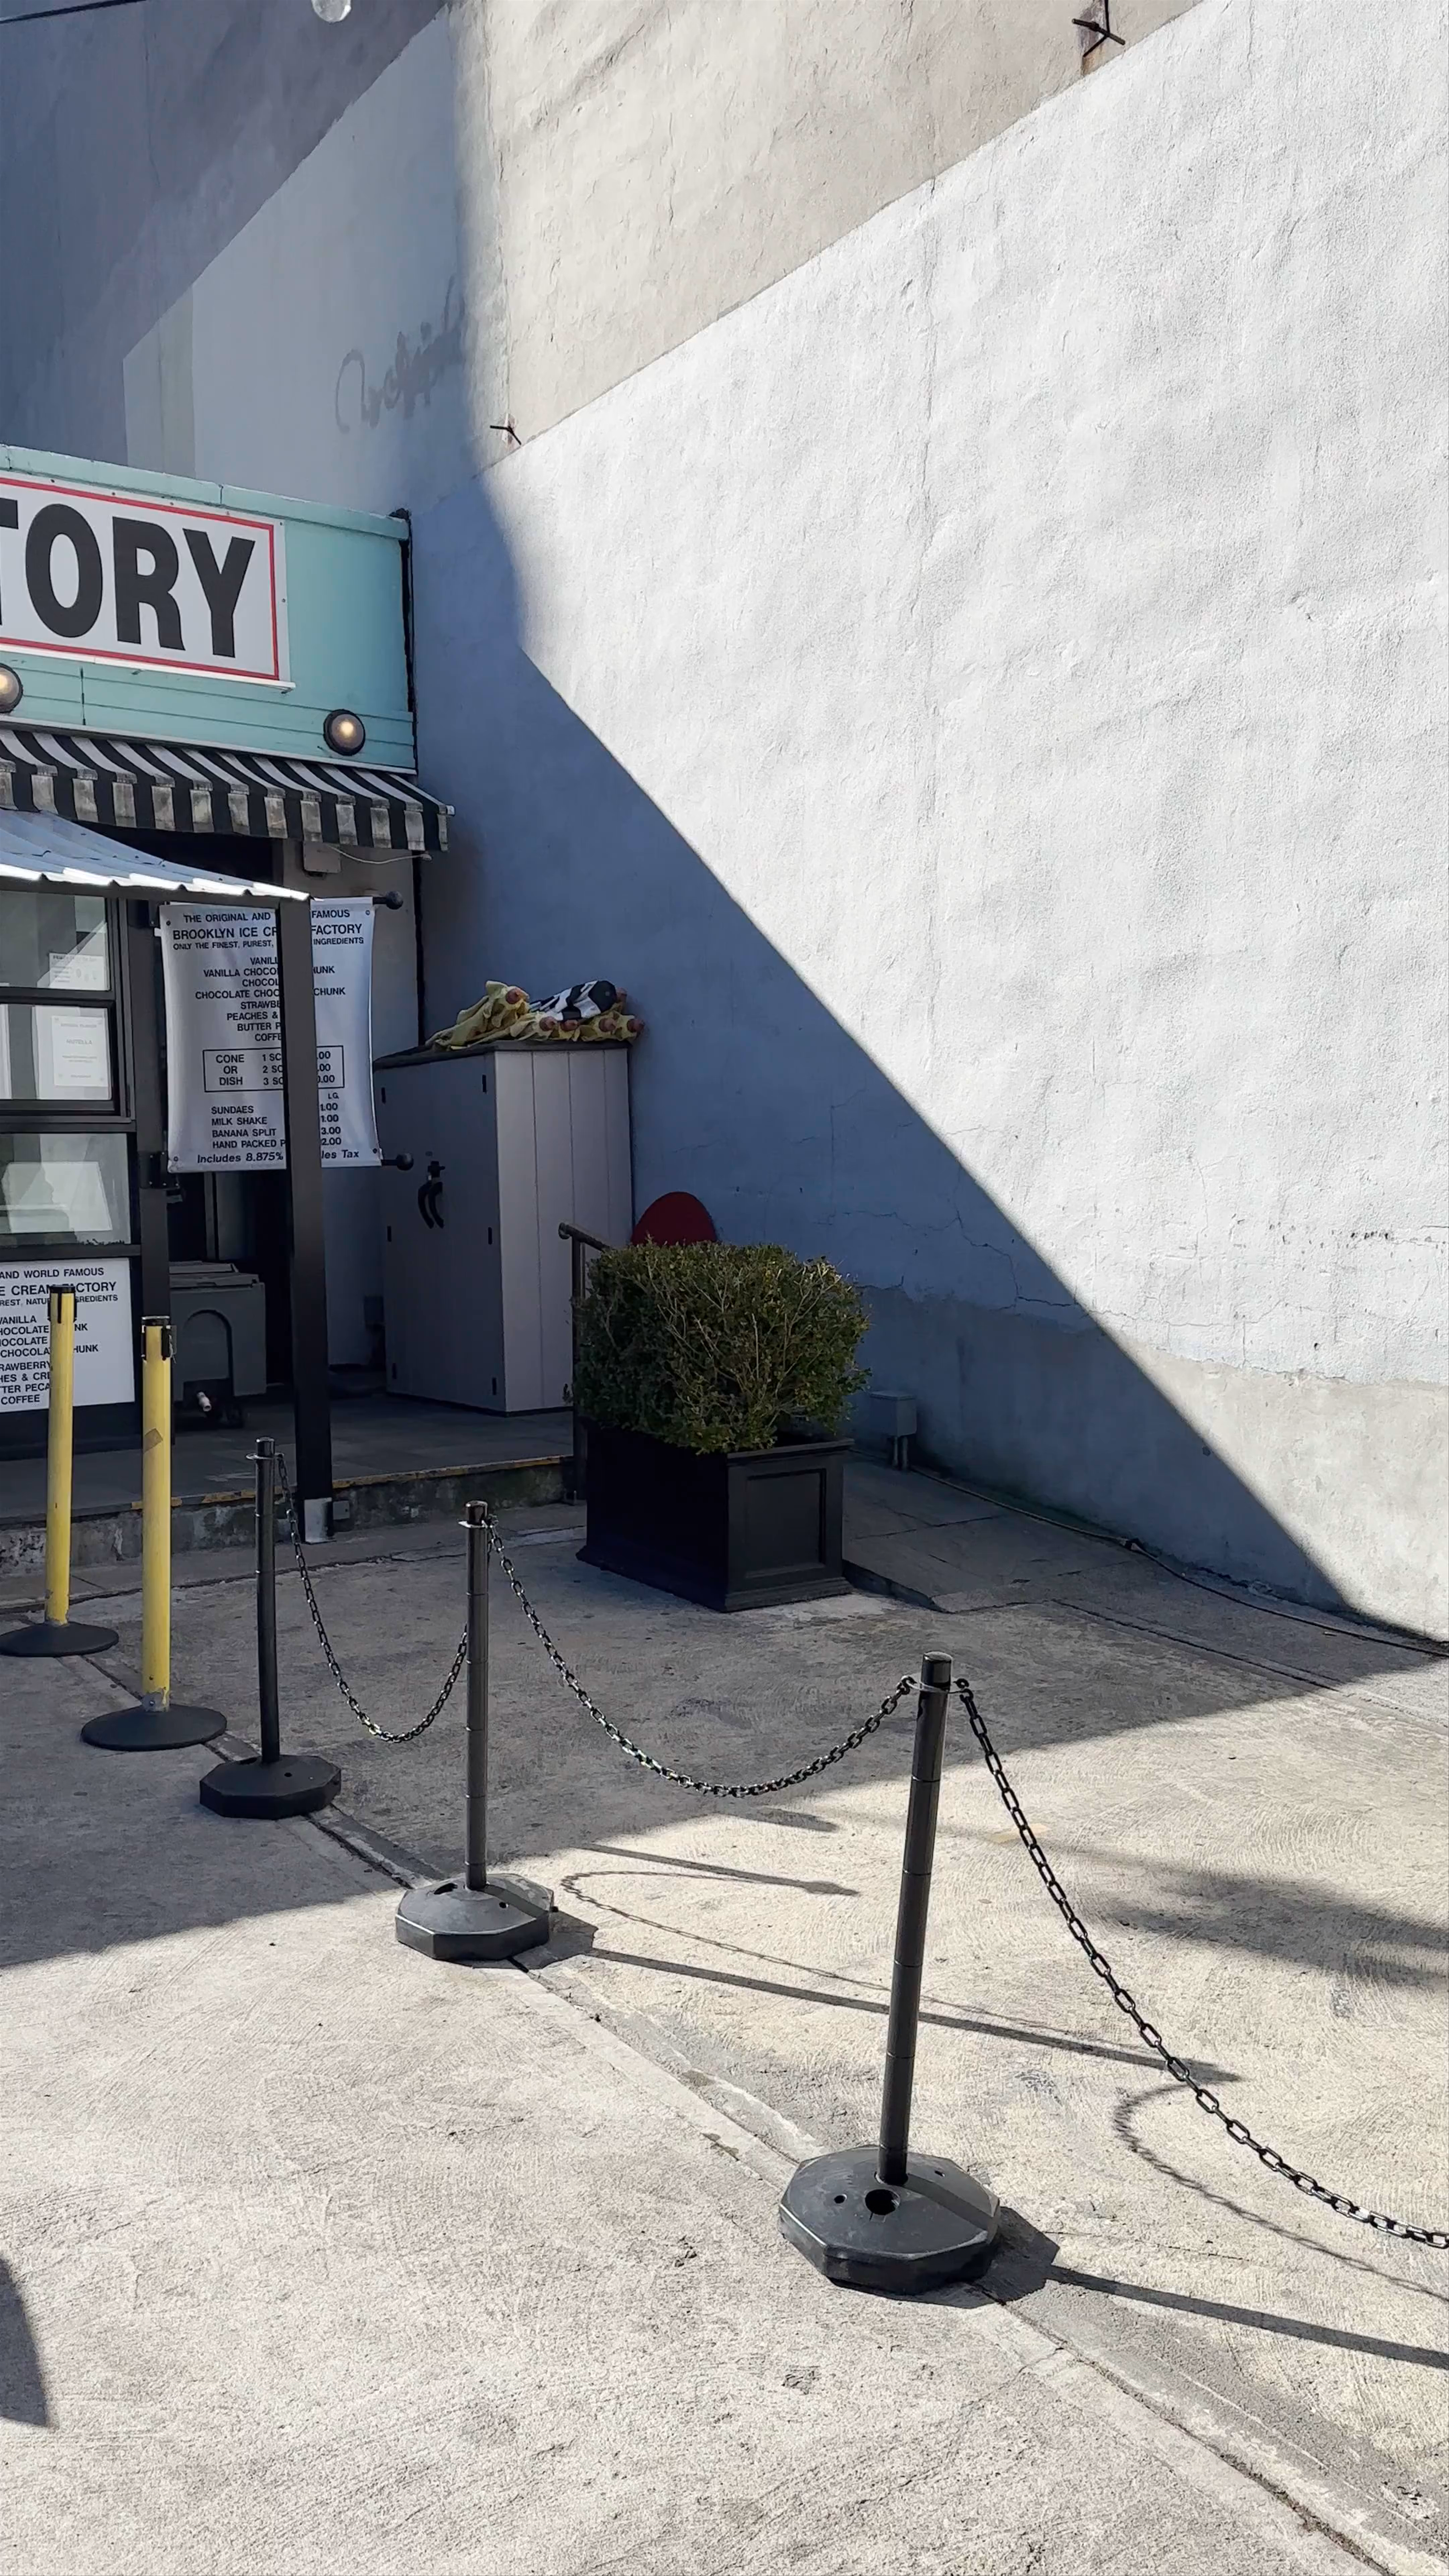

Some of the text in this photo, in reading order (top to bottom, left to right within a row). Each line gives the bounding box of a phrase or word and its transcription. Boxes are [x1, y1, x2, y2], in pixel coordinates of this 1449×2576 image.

[206, 913, 248, 922] ORIGINAL
[252, 912, 271, 920] AND
[312, 910, 350, 918] FAMOUS
[173, 928, 234, 940] BROOKLYN
[240, 927, 258, 937] ICE
[243, 967, 278, 976] CHOCO
[242, 978, 279, 987] CHOCOL
[195, 990, 250, 999] CHOCOLATE
[314, 987, 346, 996] CHUNK
[240, 1000, 280, 1009] STRAWBE
[227, 1012, 268, 1021] PEACHES
[237, 1022, 272, 1031] BUTTER
[255, 1033, 282, 1041] COFFE
[216, 1054, 245, 1063] CONE
[223, 1066, 238, 1074] OR
[219, 1077, 243, 1086] DISH
[211, 1106, 254, 1114] SUNDAES
[237, 1117, 267, 1125] SHAKE
[242, 1139, 277, 1148] PACKED
[197, 1150, 359, 1163] Includes 8.875% les Tax
[24, 1270, 59, 1278] WORLD
[64, 1267, 104, 1276] FAMOUS
[0, 1336, 47, 1347] OCOLATE
[0, 1347, 51, 1358] CHOCOLA
[25, 1383, 50, 1392] PECA
[1, 1394, 40, 1405] COFFEE
